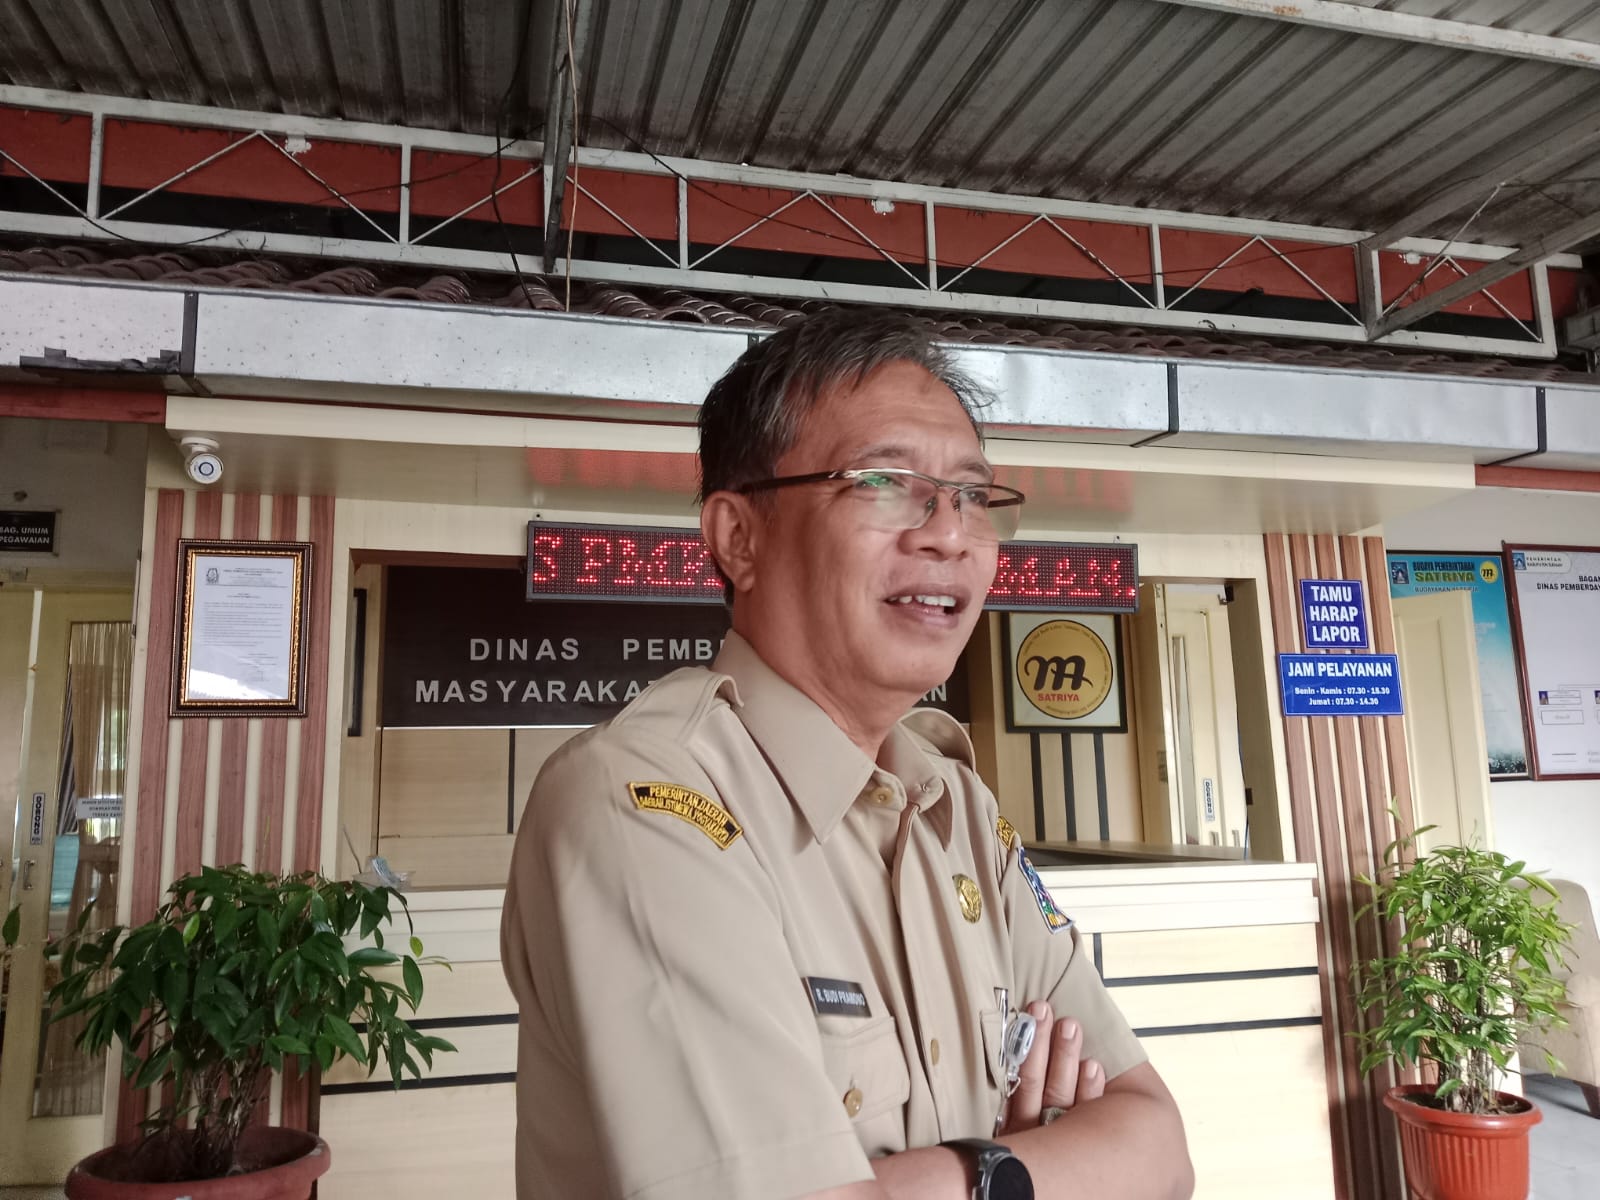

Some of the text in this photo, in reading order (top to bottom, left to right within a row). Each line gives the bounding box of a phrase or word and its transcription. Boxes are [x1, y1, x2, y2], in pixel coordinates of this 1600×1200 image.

[21, 527, 49, 535] UMUM
[1414, 572, 1474, 582] SATRIYA
[1310, 585, 1352, 602] TAMU
[1309, 605, 1359, 622] HARAP
[1312, 625, 1361, 642] LAPOR
[470, 638, 725, 661] DINAS PEMB
[1288, 662, 1393, 677] JAM PELAYANAN
[415, 680, 658, 703] MASYARAKA
[1038, 694, 1080, 702] SATRIYA
[649, 785, 729, 827] PEMERINTAH DAERAH
[33, 795, 42, 835] DORONG
